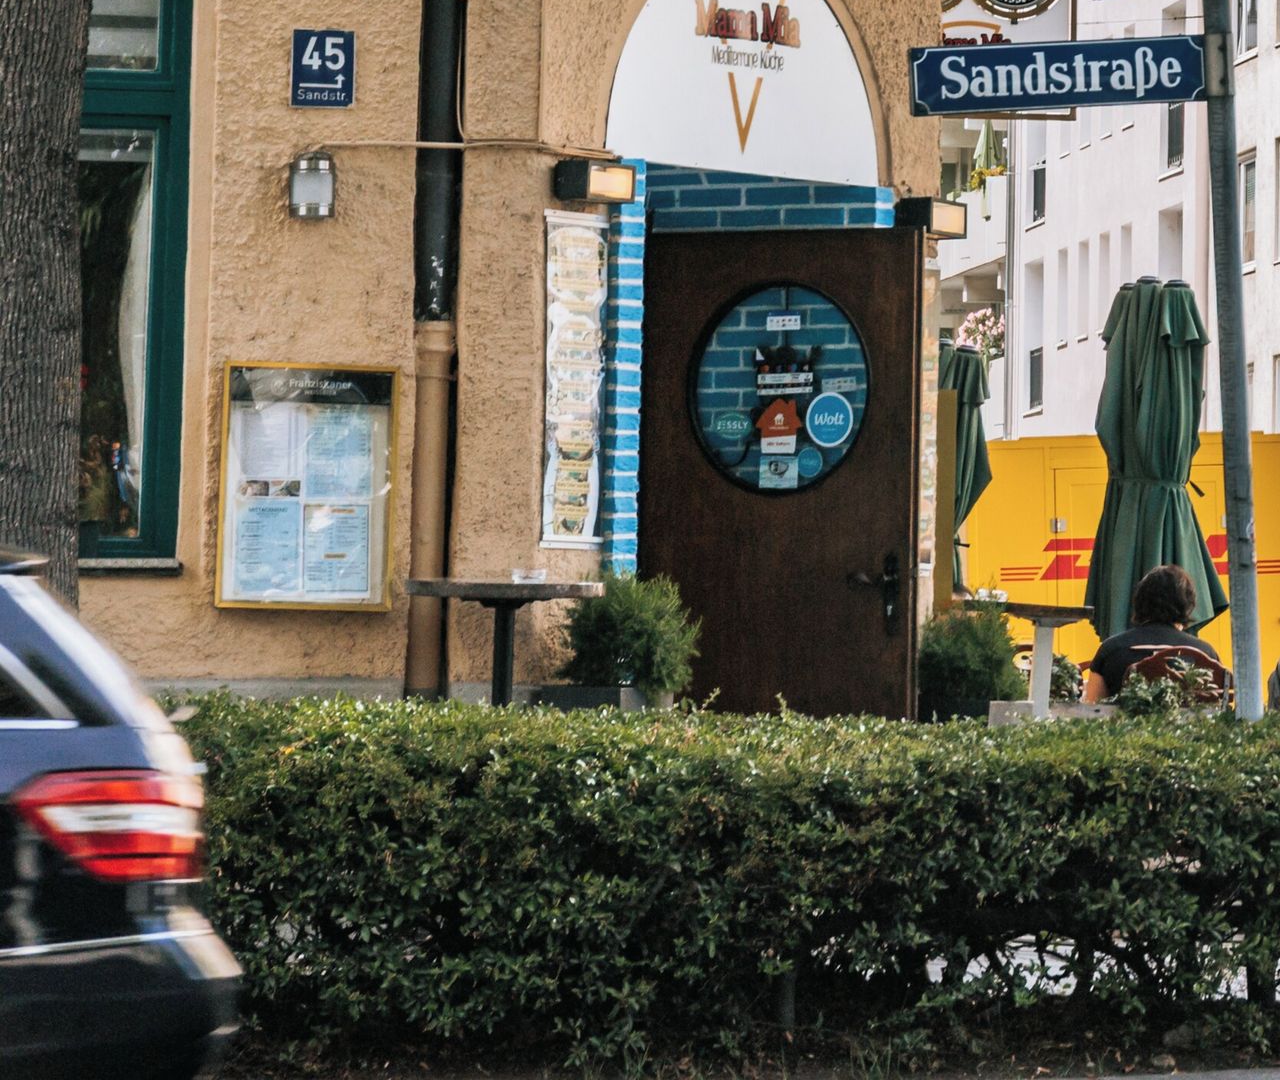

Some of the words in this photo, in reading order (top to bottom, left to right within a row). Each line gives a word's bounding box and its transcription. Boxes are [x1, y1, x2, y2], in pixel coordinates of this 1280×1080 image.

[301, 36, 346, 71] 45
[940, 46, 1182, 100] Sandstraße
[297, 88, 349, 101] Sandstr.
[814, 412, 846, 426] Wolt
